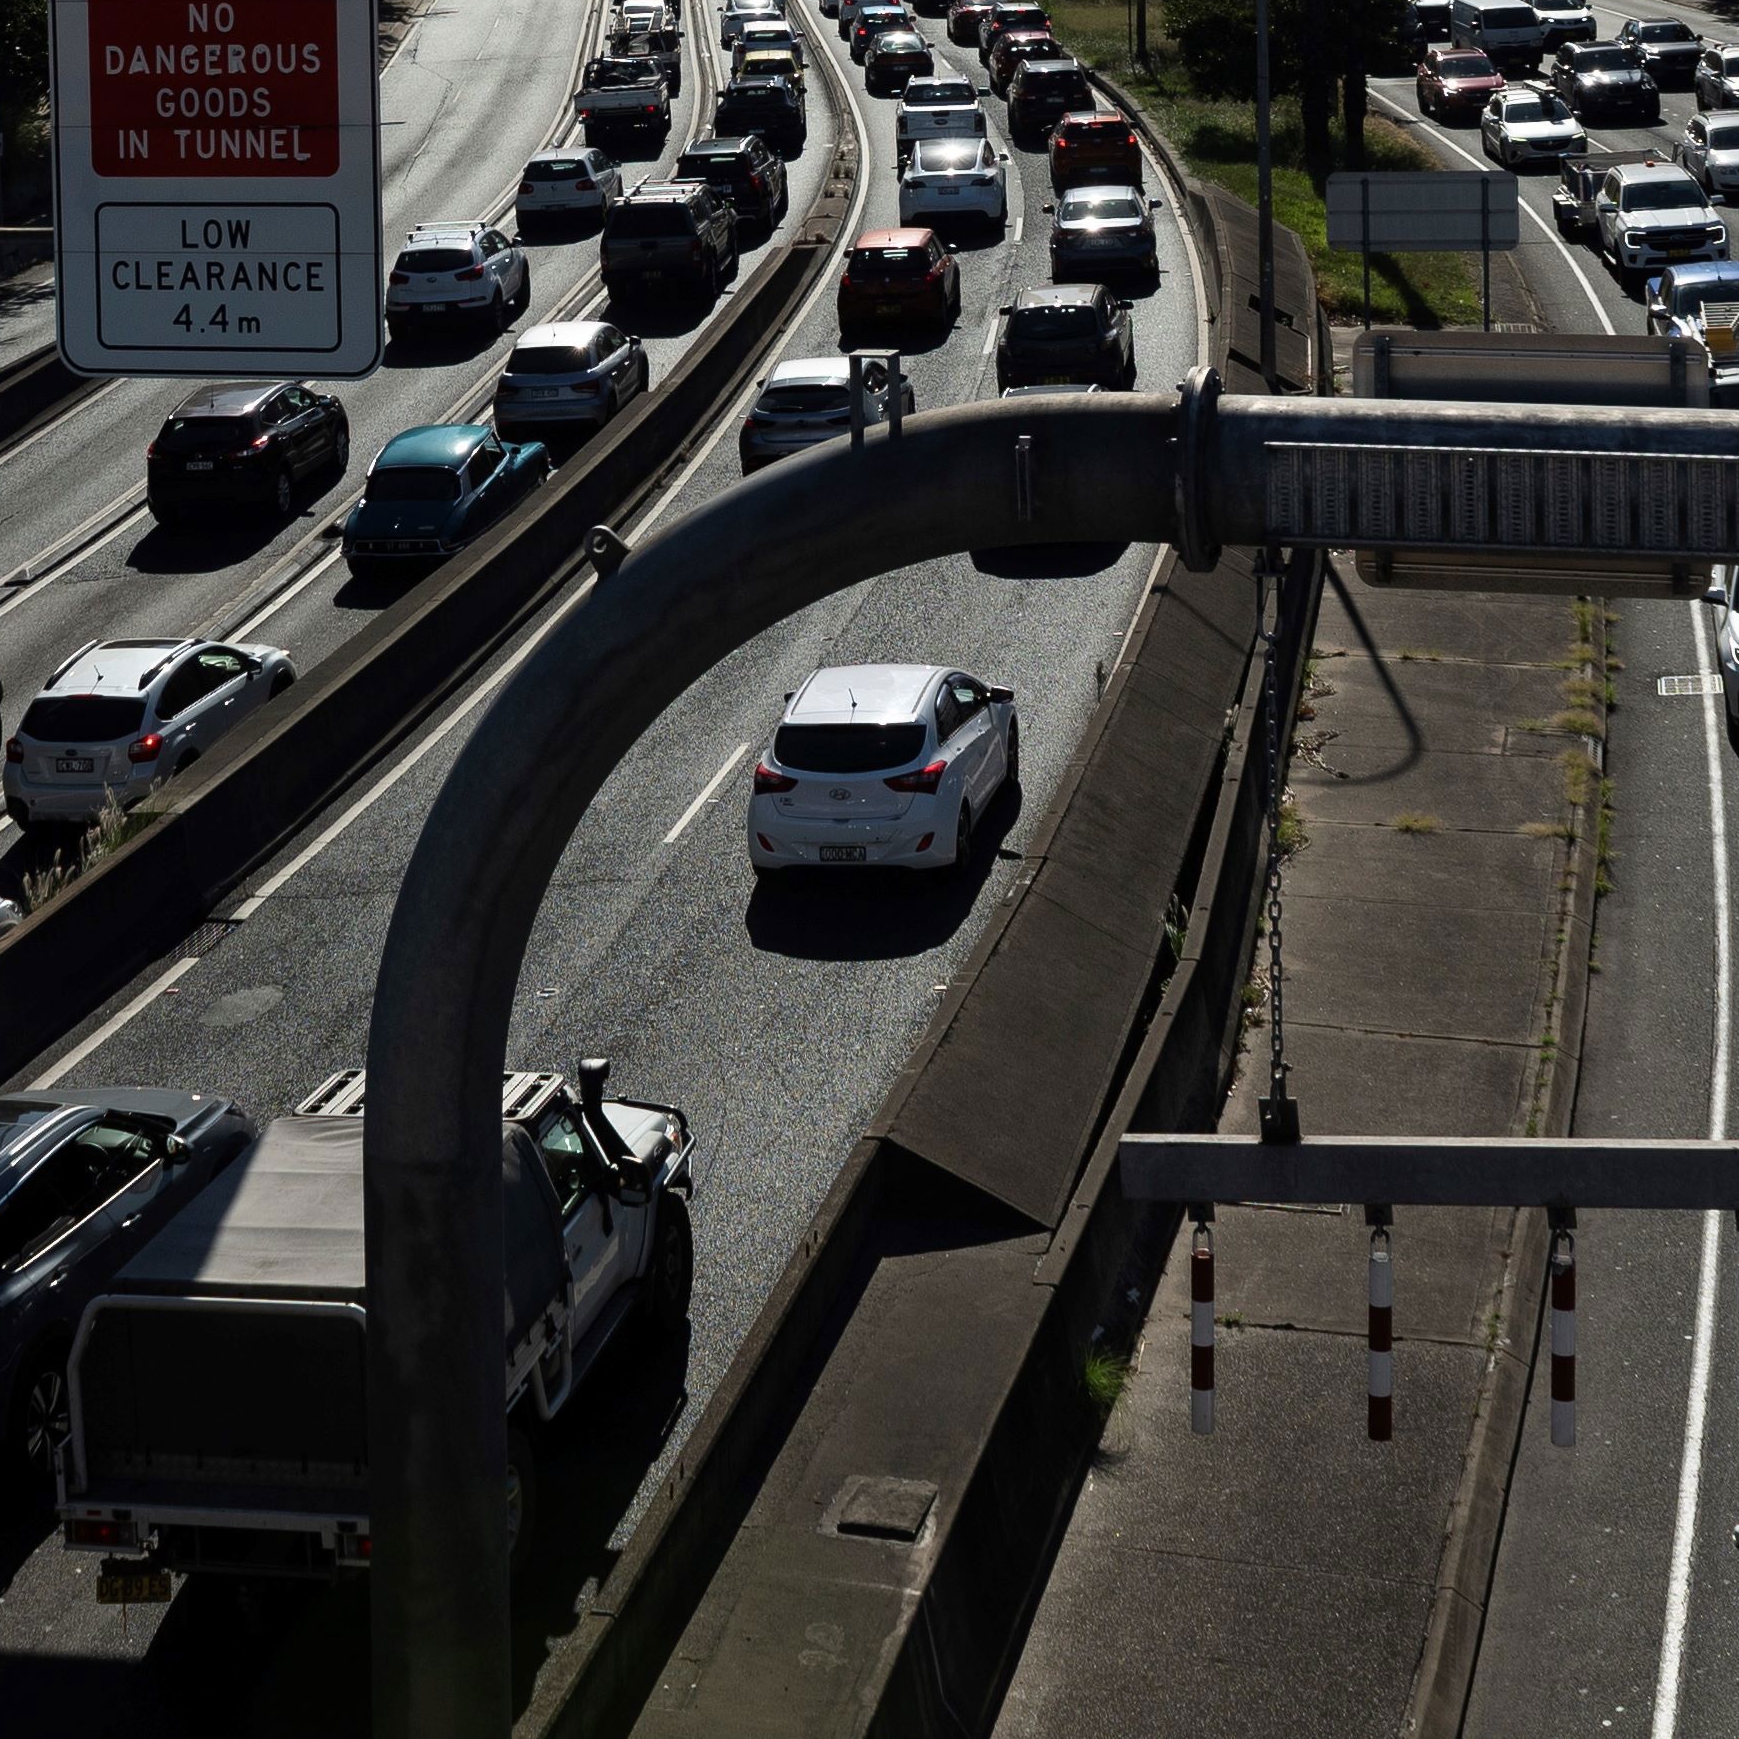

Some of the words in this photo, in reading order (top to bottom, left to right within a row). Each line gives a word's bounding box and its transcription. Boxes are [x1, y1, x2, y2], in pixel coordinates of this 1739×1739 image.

[188, 2, 235, 33] NO
[105, 43, 321, 76] DANGEROUS
[156, 87, 271, 118] GOODS
[118, 129, 149, 160] IN
[175, 128, 311, 161] TUNNEL
[181, 219, 251, 250] LOW
[112, 260, 325, 292] CLEARANCE
